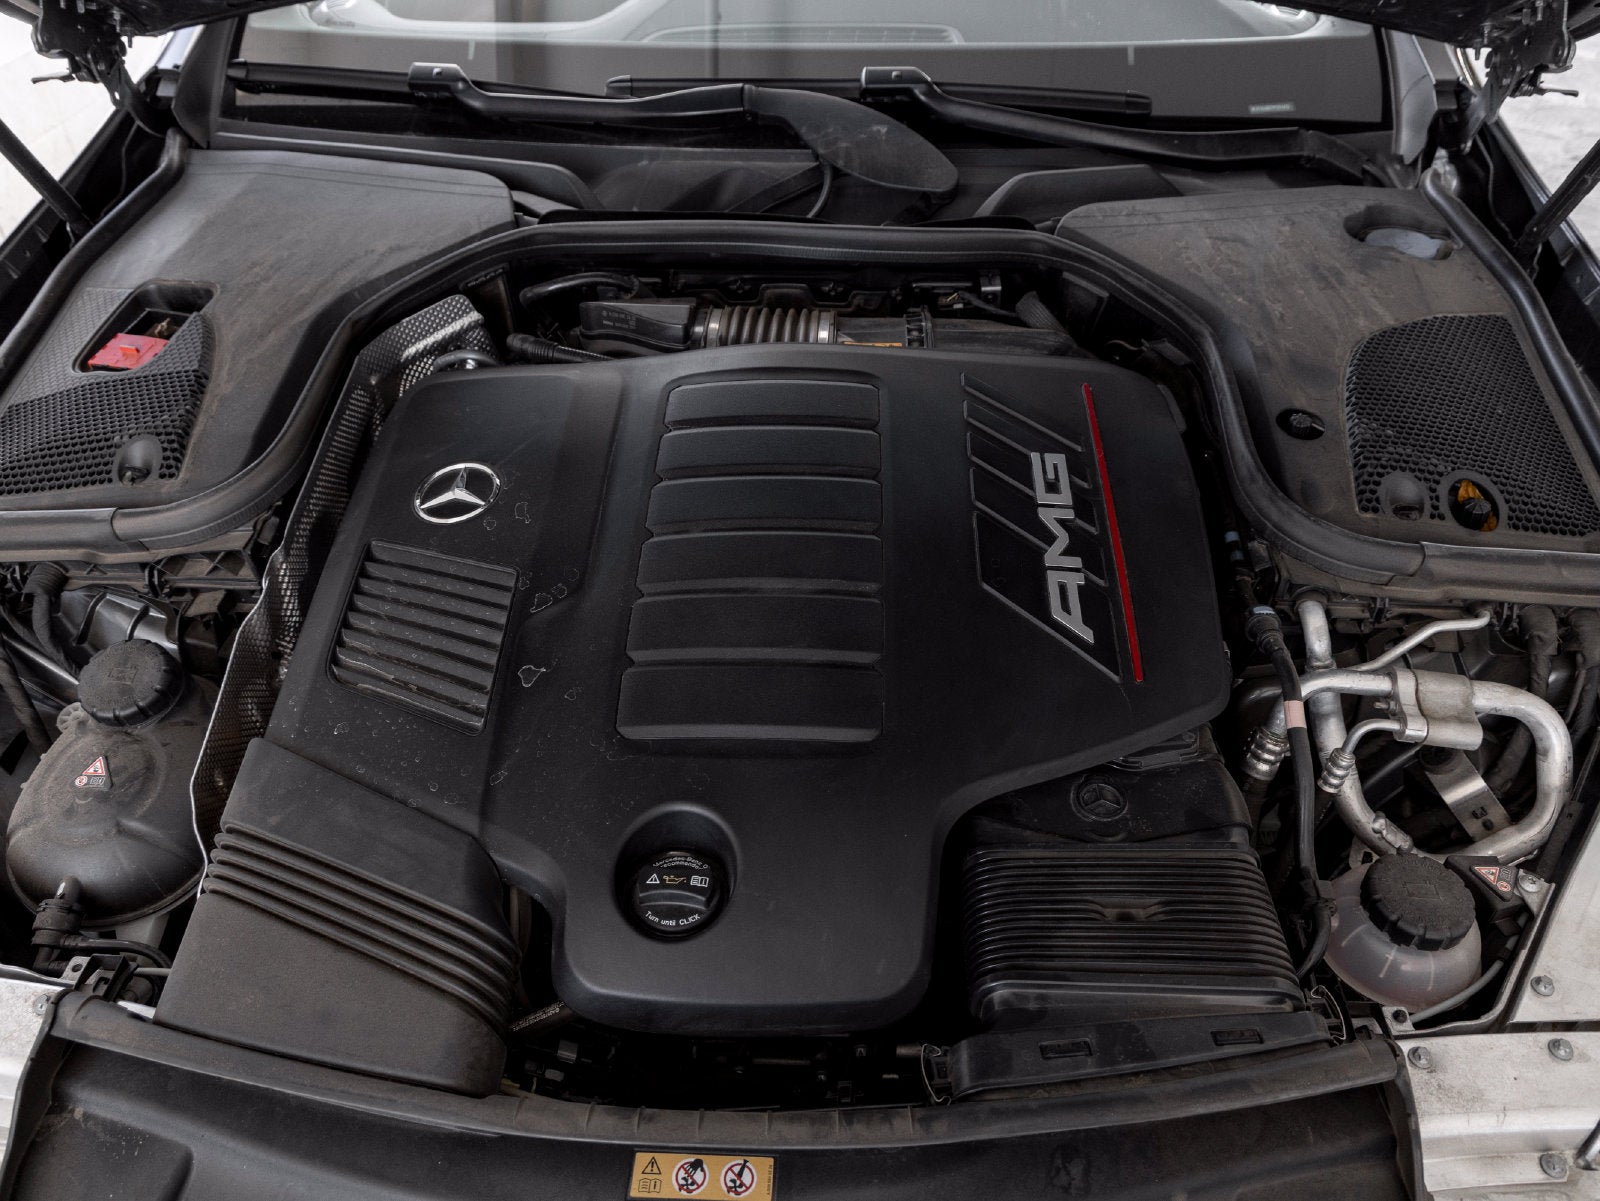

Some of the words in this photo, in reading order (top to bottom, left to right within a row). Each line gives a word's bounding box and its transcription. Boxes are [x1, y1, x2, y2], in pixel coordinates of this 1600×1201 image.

[1031, 452, 1095, 644] AMG
[645, 910, 660, 923] Turn
[679, 913, 701, 926] CLICK
